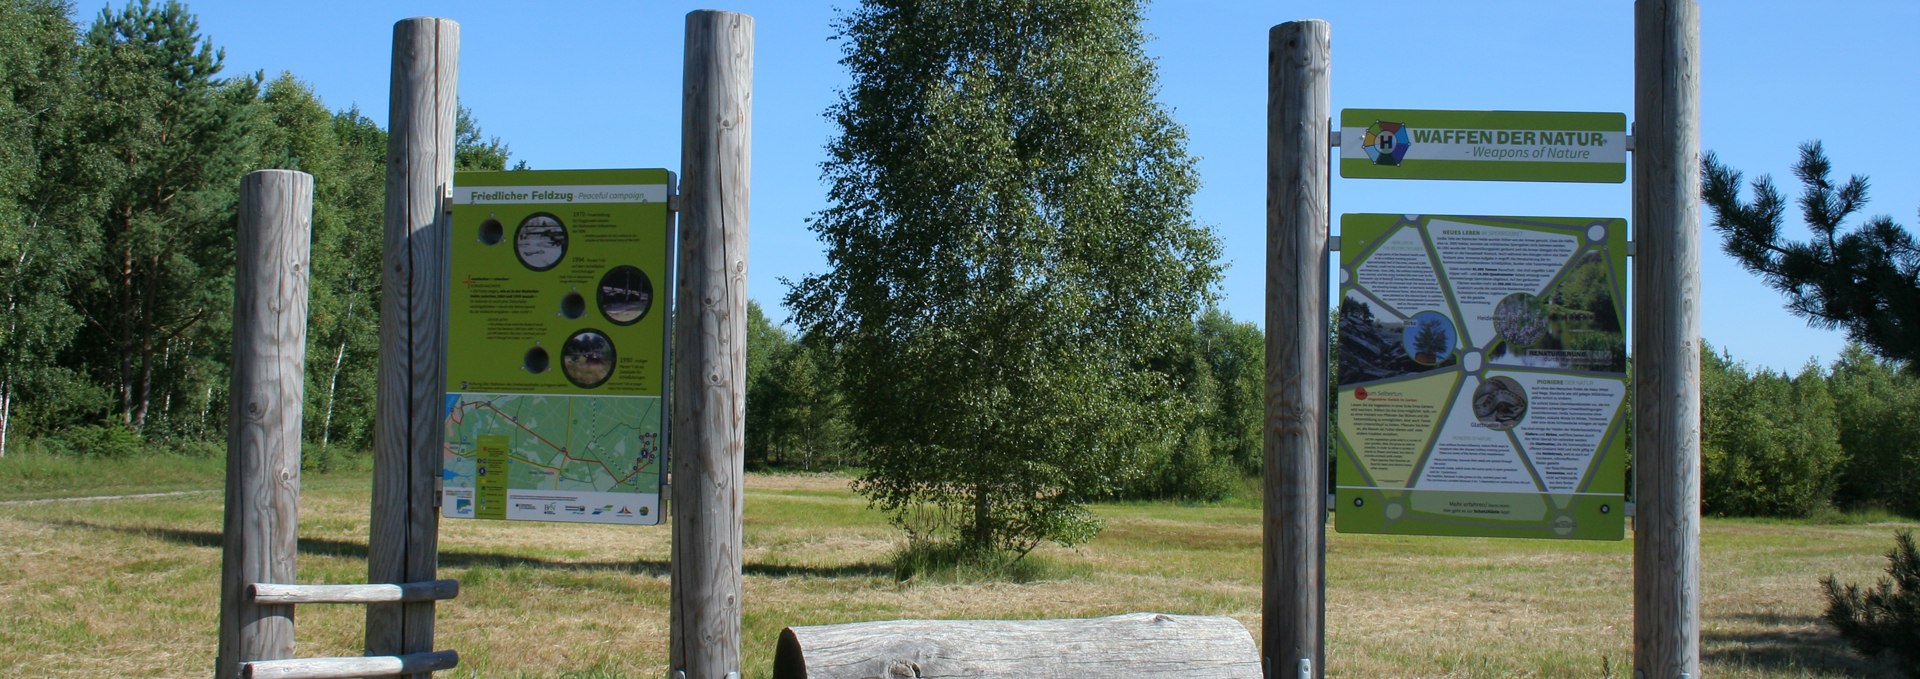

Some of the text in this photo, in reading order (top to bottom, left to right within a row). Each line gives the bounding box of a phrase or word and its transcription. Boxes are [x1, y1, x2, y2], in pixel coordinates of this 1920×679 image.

[1380, 135, 1393, 149] H
[1413, 129, 1493, 145] WAFFEN
[1497, 131, 1536, 146] DER
[1473, 146, 1529, 160] Weapons
[1532, 146, 1546, 159] of
[1547, 147, 1590, 160] Nature
[471, 190, 529, 201] Friedlicher
[531, 190, 574, 202] Feldzug
[578, 191, 609, 201] Peaceful
[609, 191, 645, 201] campaign
